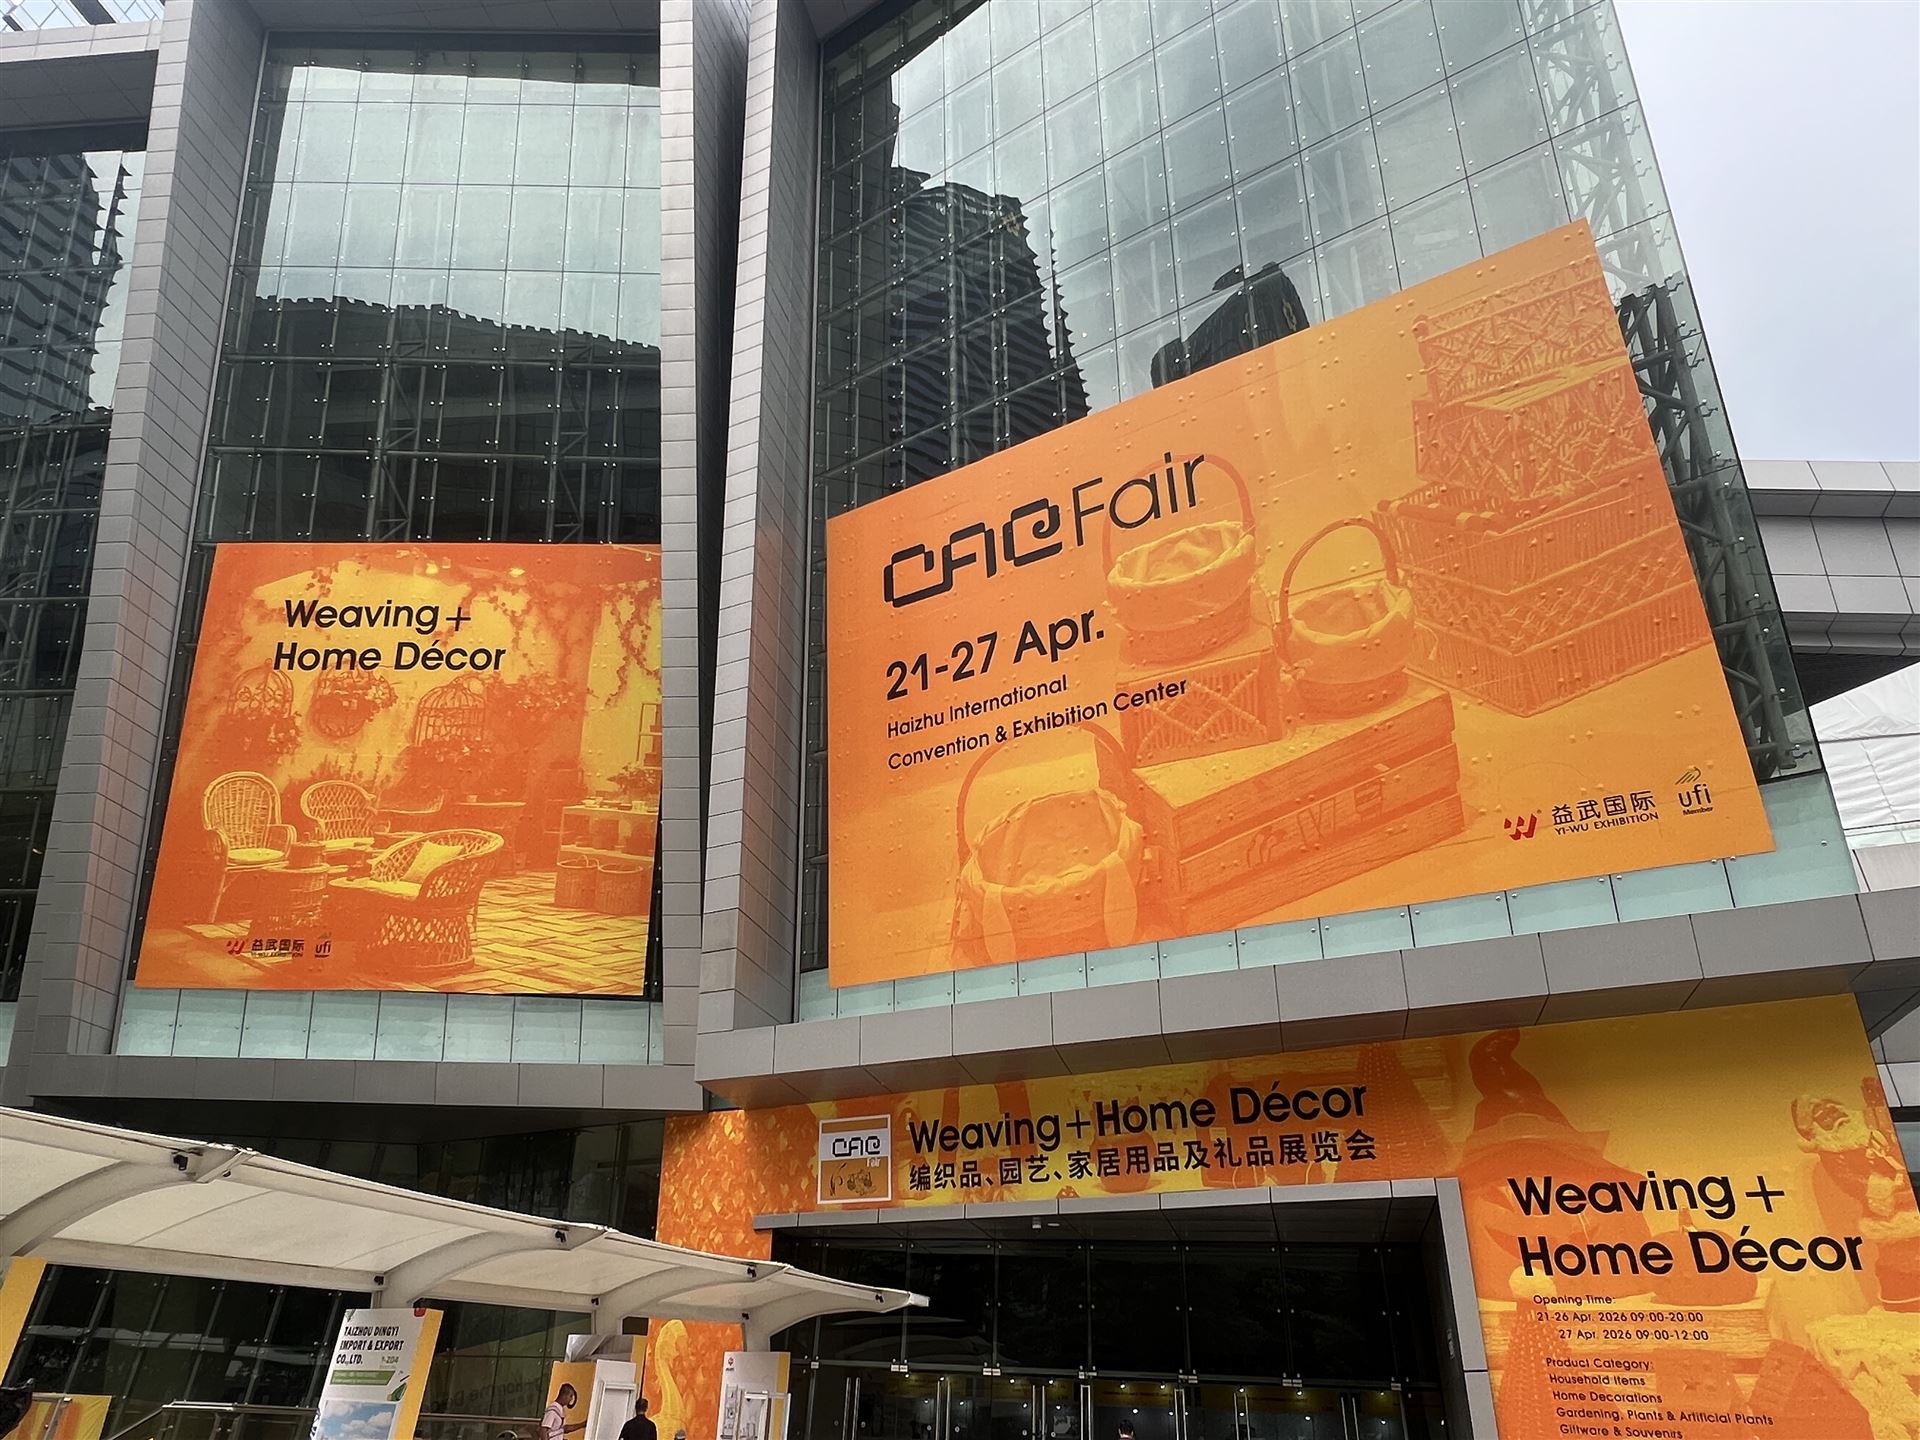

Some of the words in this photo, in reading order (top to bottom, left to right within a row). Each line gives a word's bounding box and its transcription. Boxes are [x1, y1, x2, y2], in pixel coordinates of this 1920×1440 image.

[273, 642, 382, 671] Home
[394, 639, 507, 671] Décor
[886, 632, 998, 701] 21-27
[1013, 609, 1105, 663] Apr.
[887, 706, 945, 739] Haizhu
[949, 674, 1068, 723] International
[888, 726, 990, 770] Convention
[995, 725, 1008, 743] &
[1013, 700, 1108, 740] Exhibition
[1113, 678, 1188, 713] Center
[1552, 790, 1656, 825] 益武国际
[1555, 823, 1589, 836] YI-WU
[1594, 812, 1659, 830] EXHIBITION
[1229, 1080, 1368, 1124] Décor
[1517, 1236, 1674, 1277] Home
[1687, 1225, 1864, 1275] Décor
[1533, 1294, 1582, 1306] Opening
[1585, 1295, 1616, 1304] Time:
[1536, 1312, 1569, 1322] 21-26
[1573, 1312, 1595, 1323] Apr.
[1598, 1312, 1628, 1322] 2026
[1630, 1312, 1704, 1322] 09:00-20:00
[344, 1326, 373, 1336] TAIZHOU
[1558, 1329, 1572, 1339] 27
[1602, 1329, 1632, 1339] 2026
[1636, 1330, 1709, 1340] 09:00-12:00
[339, 1340, 367, 1350] IMPORT
[367, 1340, 373, 1350] &
[374, 1340, 404, 1350] EXPORT
[1546, 1357, 1590, 1368] Product
[1593, 1358, 1654, 1371] Category:
[1549, 1374, 1610, 1385] Household
[1614, 1375, 1646, 1386] Items
[1552, 1390, 1586, 1401] Home
[1590, 1391, 1662, 1404] Decorations
[1556, 1407, 1624, 1422] Gardening,
[1627, 1409, 1663, 1421] Plants
[1666, 1411, 1675, 1421] &
[1680, 1412, 1732, 1424] Artificial
[1736, 1413, 1774, 1426] Plants
[1560, 1423, 1609, 1436] Giftware
[1613, 1426, 1622, 1436] &
[1626, 1426, 1683, 1440] Souvenirs
